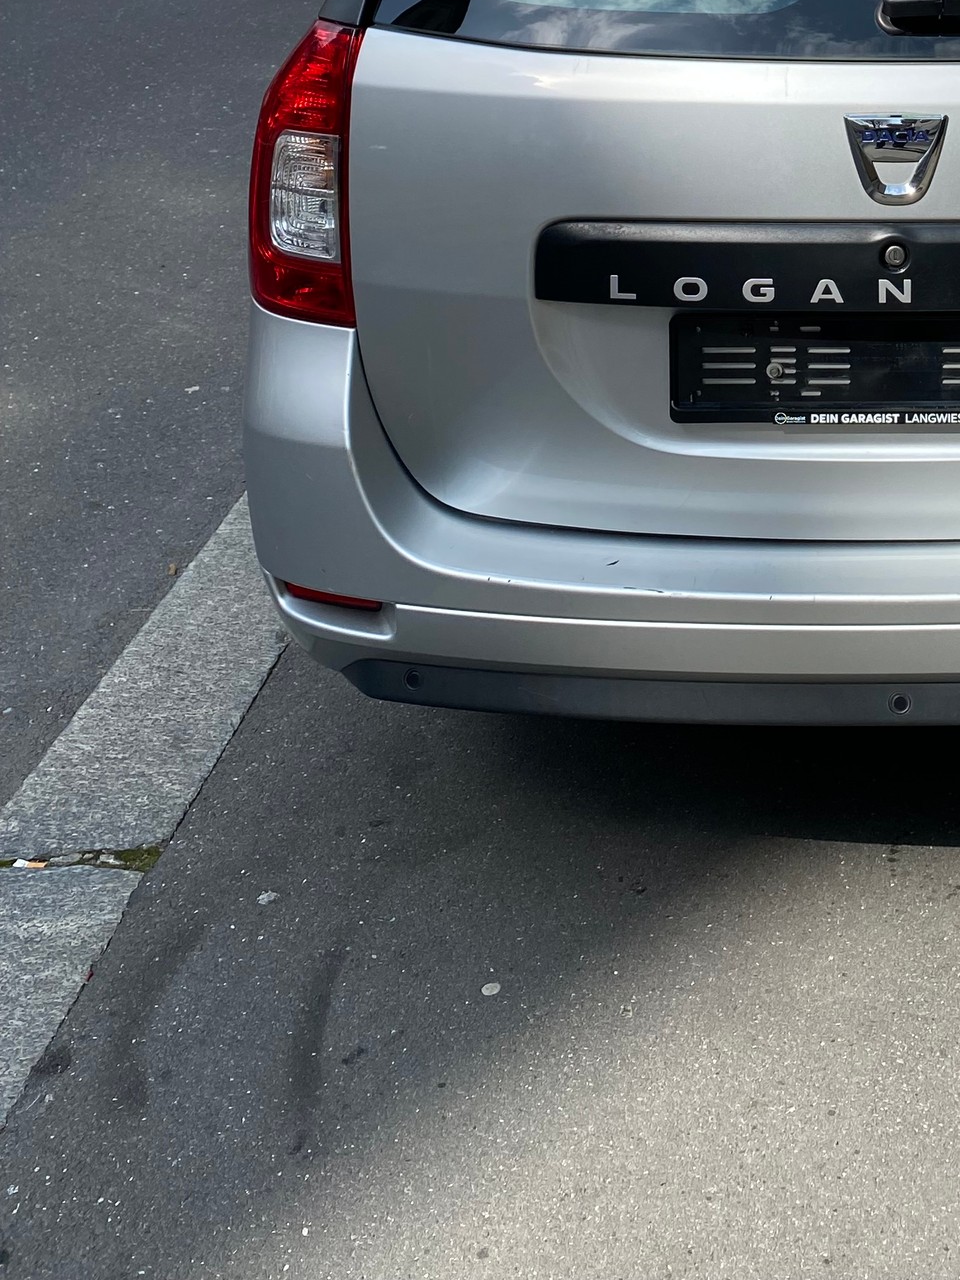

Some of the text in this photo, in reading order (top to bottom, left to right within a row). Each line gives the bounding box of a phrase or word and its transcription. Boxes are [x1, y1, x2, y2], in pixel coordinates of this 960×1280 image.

[861, 130, 929, 143] DACIA
[610, 274, 912, 303] LOGAN
[810, 413, 839, 424] DEIN
[841, 413, 900, 424] GARAGIST
